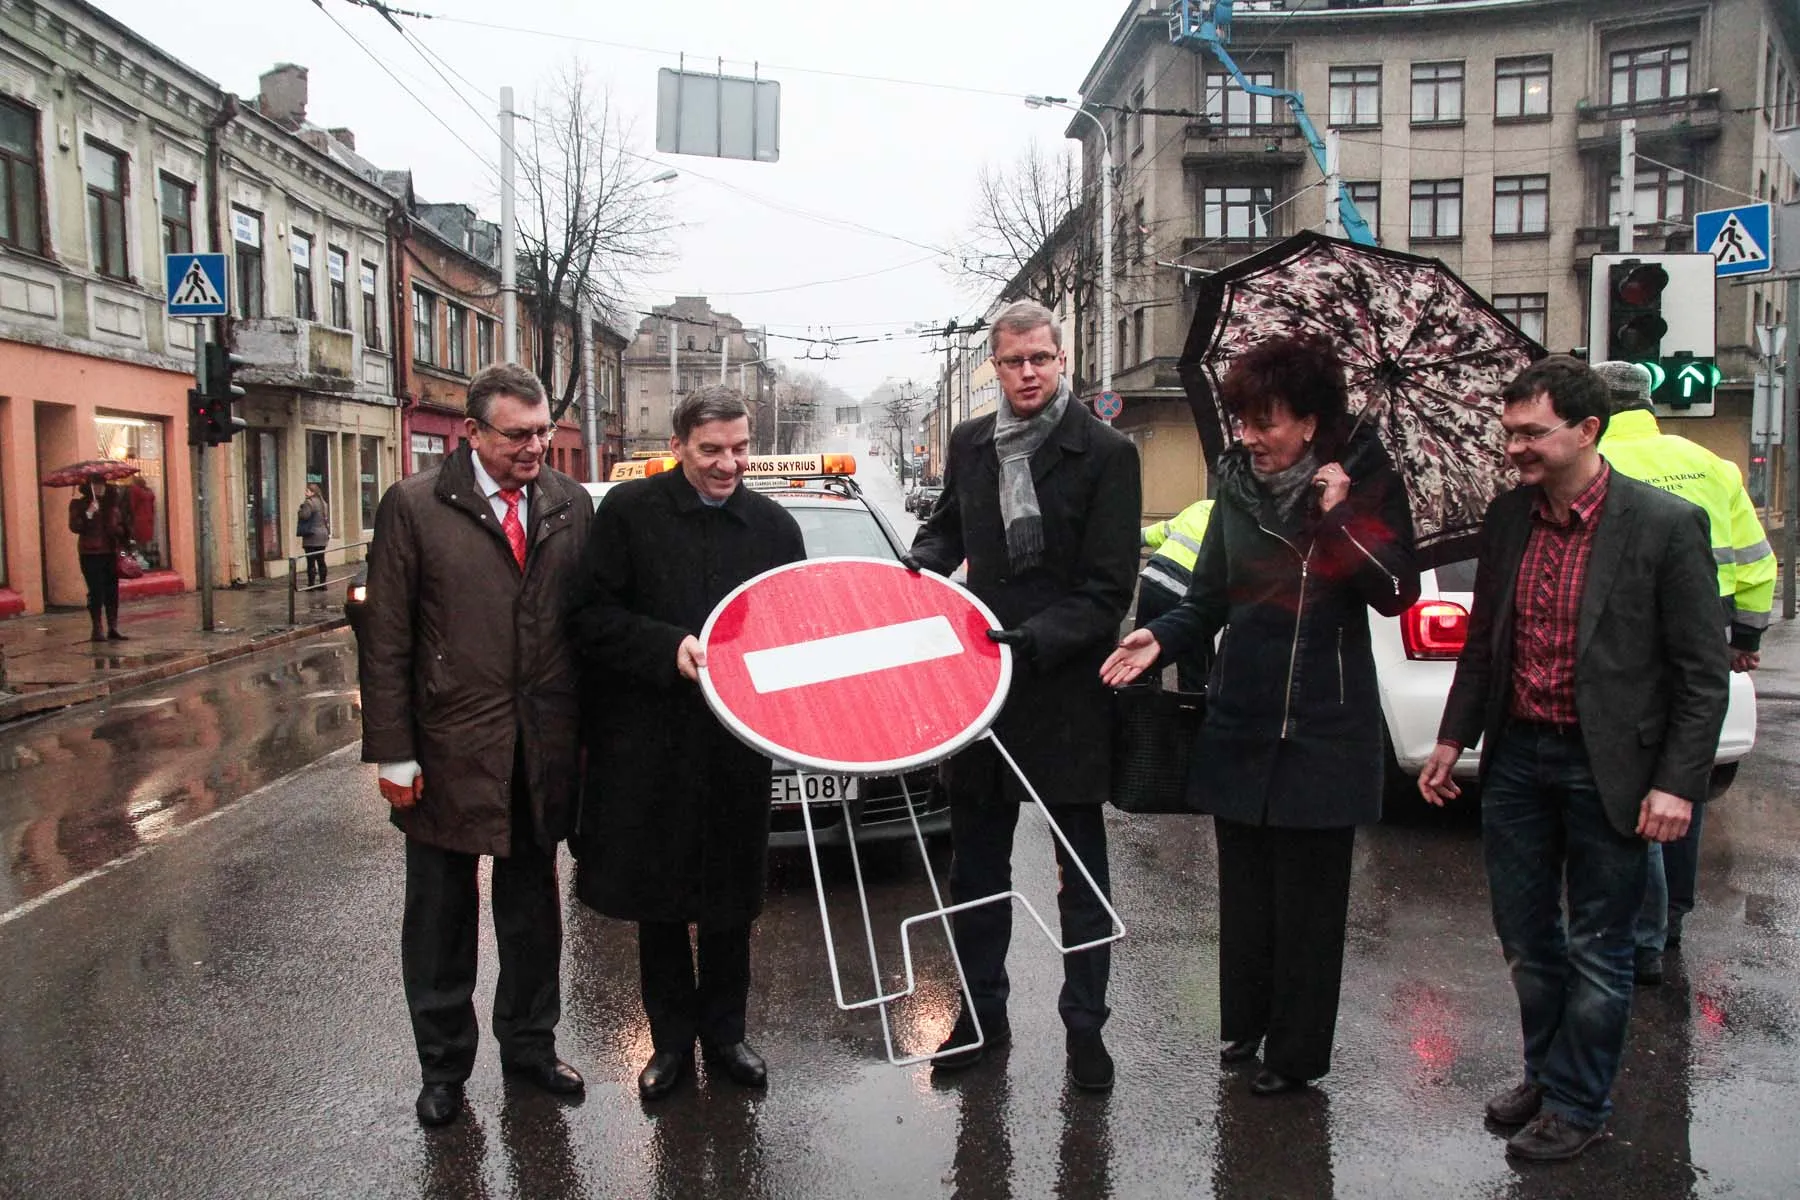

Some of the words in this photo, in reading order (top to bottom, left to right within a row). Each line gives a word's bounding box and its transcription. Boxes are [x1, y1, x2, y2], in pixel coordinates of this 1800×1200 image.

[616, 466, 634, 478] 51
[744, 461, 774, 472] ARKOS
[777, 460, 816, 471] SKYRIUS
